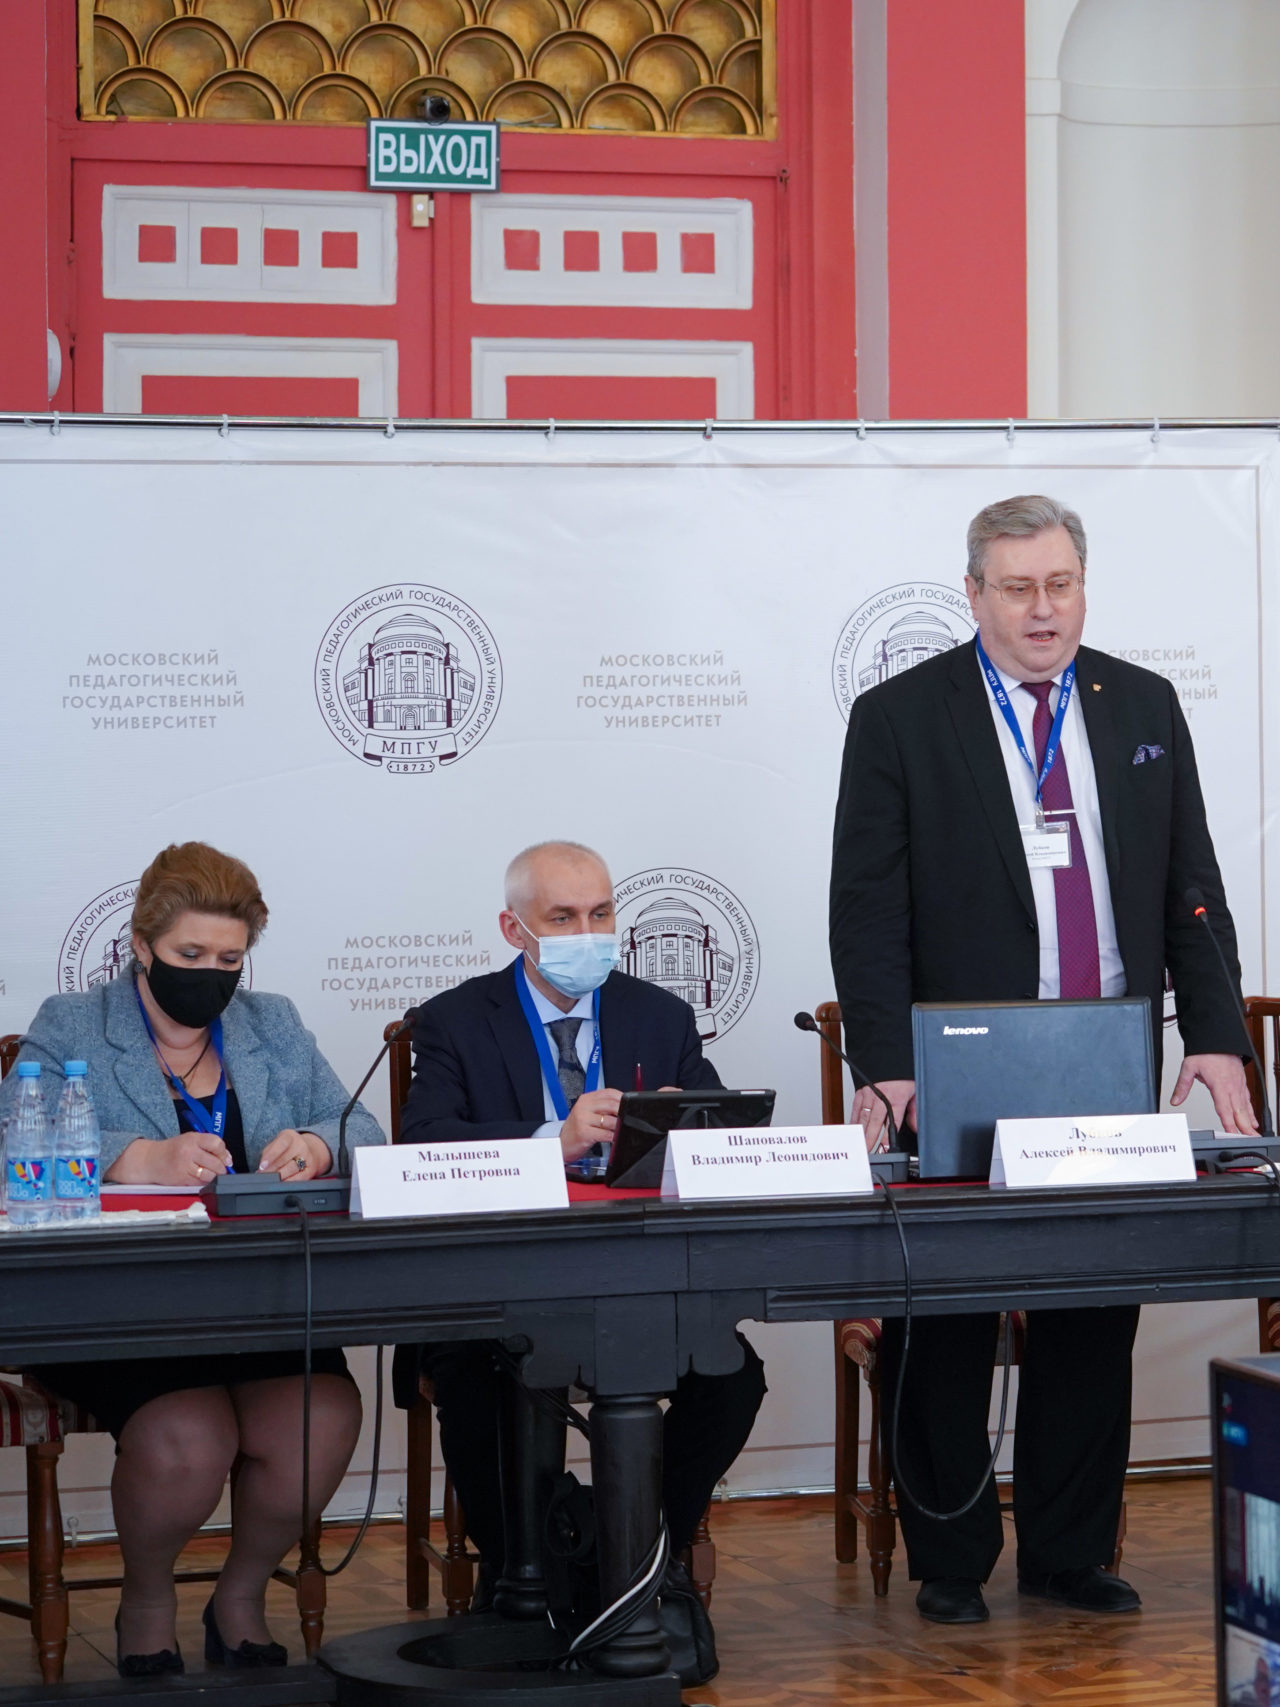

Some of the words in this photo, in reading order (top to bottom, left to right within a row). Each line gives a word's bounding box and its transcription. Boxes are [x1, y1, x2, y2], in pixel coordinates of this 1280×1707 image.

[378, 132, 489, 179] ВЫХОД
[322, 588, 404, 664] ПЕДАГОГИЧЕСКИЙ
[408, 589, 497, 666] ГОСУДАРСТВЕННЫЙ
[840, 587, 916, 660] ПЕДАГОГИЧЕСКИЙ
[86, 649, 220, 667] МОСКОВСКИЙ
[599, 649, 724, 668] МОСКОВСКИЙ
[68, 669, 238, 690] ПЕДАГОГИЧЕСКИЙ
[582, 669, 742, 690] ПЕДАГОГИЧЕСКИЙ
[986, 668, 999, 687] МПГУ
[996, 689, 1008, 707] 1872
[1064, 671, 1074, 688] 1872
[62, 690, 246, 711] ГОСУДАРСТВЕННЫЙ
[320, 668, 360, 747] МОСКОВСКИЙ
[462, 668, 497, 746] УНИВЕРСИТЕТ
[576, 690, 749, 711] ГОСУДАРСТВЕННЫЙ
[1060, 691, 1069, 710] МПГУ
[91, 715, 218, 730] УНИВЕРСИТЕТ
[603, 714, 723, 729] УНИВЕРСИТЕТ
[380, 739, 439, 755] МПГУ
[395, 763, 427, 773] 1872
[344, 930, 474, 949] МОСКОВСКИЙ
[669, 873, 754, 948] ГОСУДАРСТВЕННЫЙ
[720, 947, 756, 1027] УНИВЕРСИТЕТ
[326, 950, 492, 972] ПЕДАГОГИЧЕСКИЙ
[349, 996, 431, 1012] УНИВЕРС
[943, 1025, 989, 1036] lenovo
[213, 1111, 223, 1133] МПГУ
[727, 1134, 808, 1147] Шаповалов
[418, 1149, 501, 1163] Малышева
[691, 1153, 763, 1166] Владимир
[765, 1151, 849, 1164] Леонидович
[1019, 1146, 1074, 1159] Алексей
[402, 1170, 447, 1182] Елена
[450, 1167, 521, 1181] Петровна
